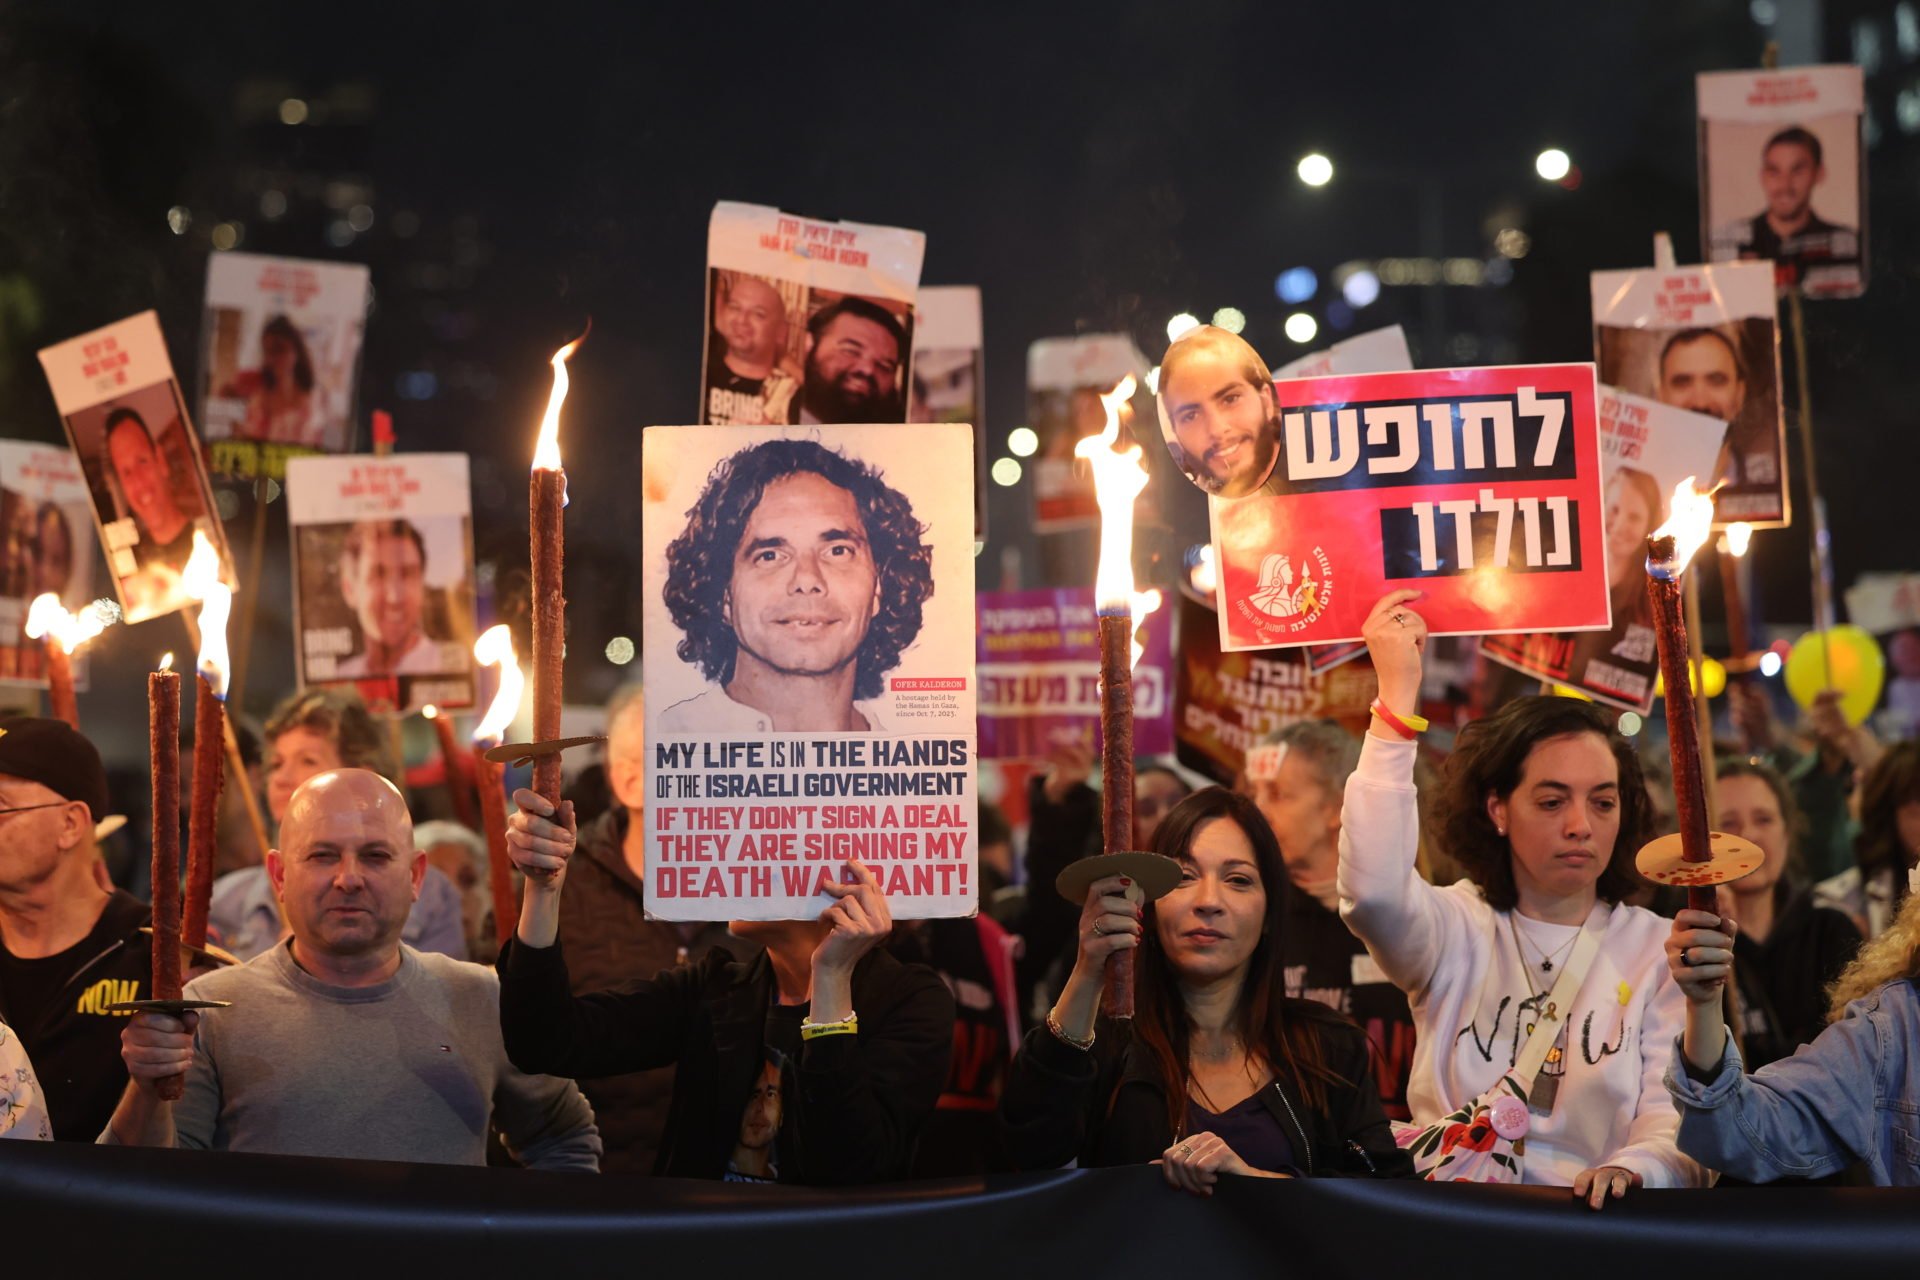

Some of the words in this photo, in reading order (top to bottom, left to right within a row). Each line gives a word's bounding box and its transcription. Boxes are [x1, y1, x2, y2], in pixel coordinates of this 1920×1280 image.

[709, 387, 763, 422] BRING
[1284, 386, 1566, 481] לחופש
[1413, 488, 1571, 571] נולדו
[920, 680, 962, 688] KALDERON
[656, 742, 697, 769] MY
[704, 742, 764, 768] LIFE
[771, 742, 785, 768] IS
[790, 741, 805, 767] IN
[812, 741, 865, 767] THE
[872, 740, 967, 767] HANDS
[656, 775, 673, 798] OF
[677, 774, 700, 798] THE
[706, 774, 799, 798] ISRAELI
[804, 772, 967, 798] GOVERNMENT
[656, 807, 678, 831] IF
[683, 806, 745, 830] THEY
[749, 806, 817, 830] DON'T
[821, 805, 875, 829] SIGN
[880, 805, 900, 828] A
[904, 804, 968, 828] DEAL
[657, 835, 731, 862] THEY
[737, 834, 797, 861] ARE
[804, 833, 917, 860] SIGNING
[925, 832, 968, 859] MY
[656, 866, 772, 898] DEATH
[77, 979, 139, 1016] NOW
